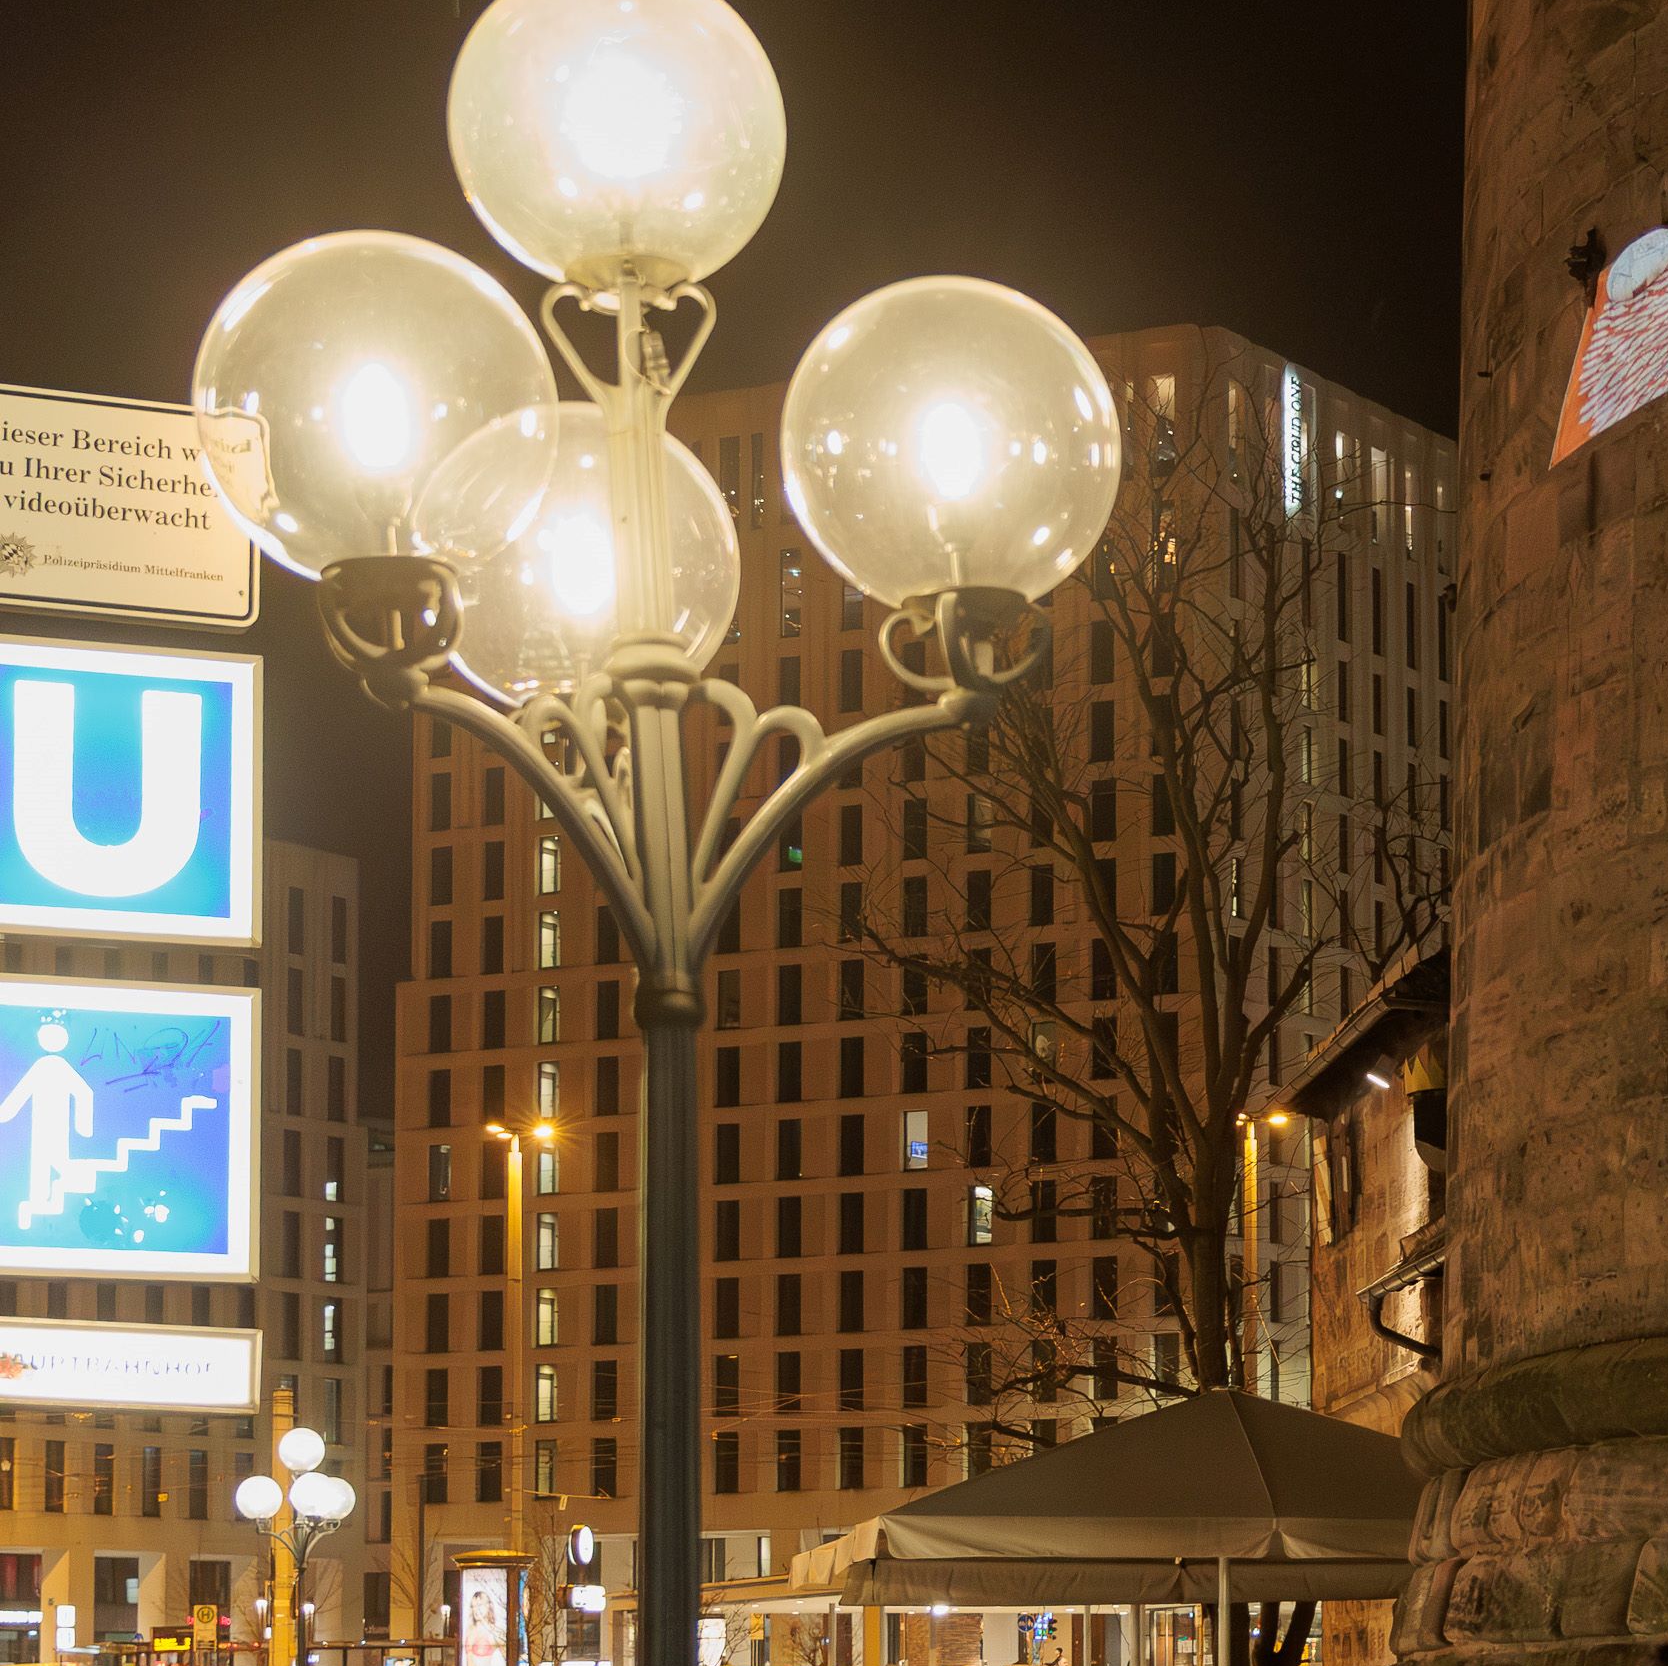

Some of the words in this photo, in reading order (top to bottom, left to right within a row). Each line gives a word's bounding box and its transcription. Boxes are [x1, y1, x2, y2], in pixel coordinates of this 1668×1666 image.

[1291, 376, 1302, 412] ONE
[0, 420, 64, 447] ieser
[72, 429, 172, 460] Bereich
[1291, 418, 1302, 467] CLOUD
[0, 460, 14, 476] u
[24, 457, 91, 483] Ihrer
[99, 464, 219, 497] Sicherhe
[1291, 469, 1303, 504] THE
[4, 490, 211, 530] videoüberwacht
[43, 554, 141, 573] Polizeipräsidium
[144, 564, 224, 582] Mittelfranken
[13, 678, 203, 897] U
